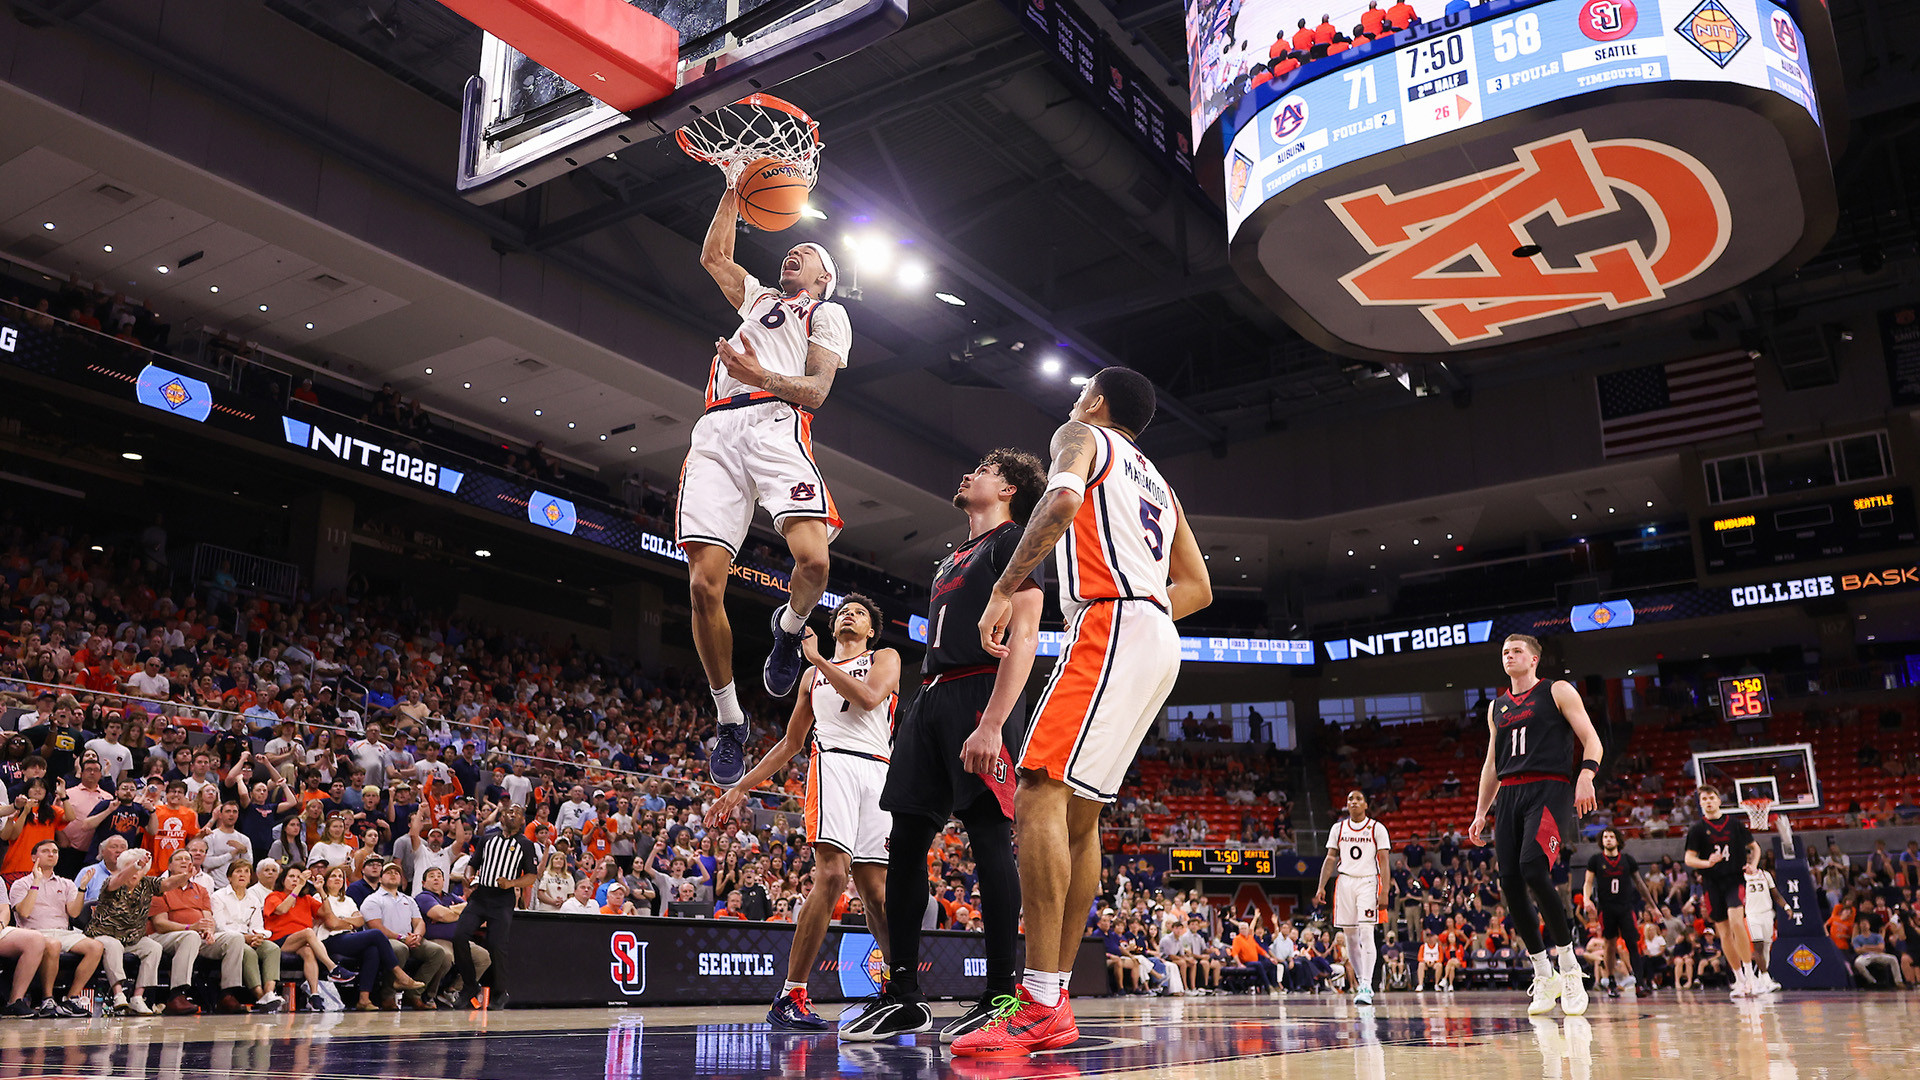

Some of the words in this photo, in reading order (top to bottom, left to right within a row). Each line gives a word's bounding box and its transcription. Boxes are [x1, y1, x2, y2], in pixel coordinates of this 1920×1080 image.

[1491, 12, 1542, 63] 58
[1696, 25, 1734, 38] NIT
[1406, 34, 1464, 78] 7:50
[1595, 44, 1638, 61] SEATTLE
[1434, 75, 1460, 94] HALF
[1495, 79, 1502, 91] 3
[1511, 62, 1559, 86] FOULS
[1577, 67, 1641, 87] TIMEOUTS
[1648, 66, 1655, 76] 2
[1343, 65, 1377, 110] 71
[1435, 106, 1450, 120] 26
[1332, 117, 1374, 141] FOULS
[1381, 115, 1387, 126] 2
[1277, 142, 1305, 164] AUBURN
[1312, 158, 1318, 169] 3
[760, 302, 785, 329] 6
[311, 425, 381, 467] NIT
[381, 449, 437, 486] 2026
[1853, 494, 1894, 510] SEATTLE
[1139, 496, 1163, 562] 5
[1713, 515, 1755, 531] AUBURN
[1731, 575, 1835, 607] COLLEGE
[933, 603, 948, 648] 1
[1350, 631, 1409, 658] NIT
[1411, 624, 1466, 650] 2026
[1213, 650, 1224, 661] 22
[1732, 677, 1762, 692] 7:50
[1730, 691, 1763, 716] 26
[1511, 726, 1527, 757] 11
[1214, 850, 1239, 863] 7:50
[1244, 850, 1270, 859] SEATTLE
[1350, 846, 1362, 860] 0
[1179, 860, 1193, 872] 71
[1226, 864, 1233, 874] 2
[1256, 861, 1271, 873] 58
[1611, 878, 1620, 894] 0
[1749, 883, 1764, 893] 33
[698, 953, 774, 976] SEATTLE
